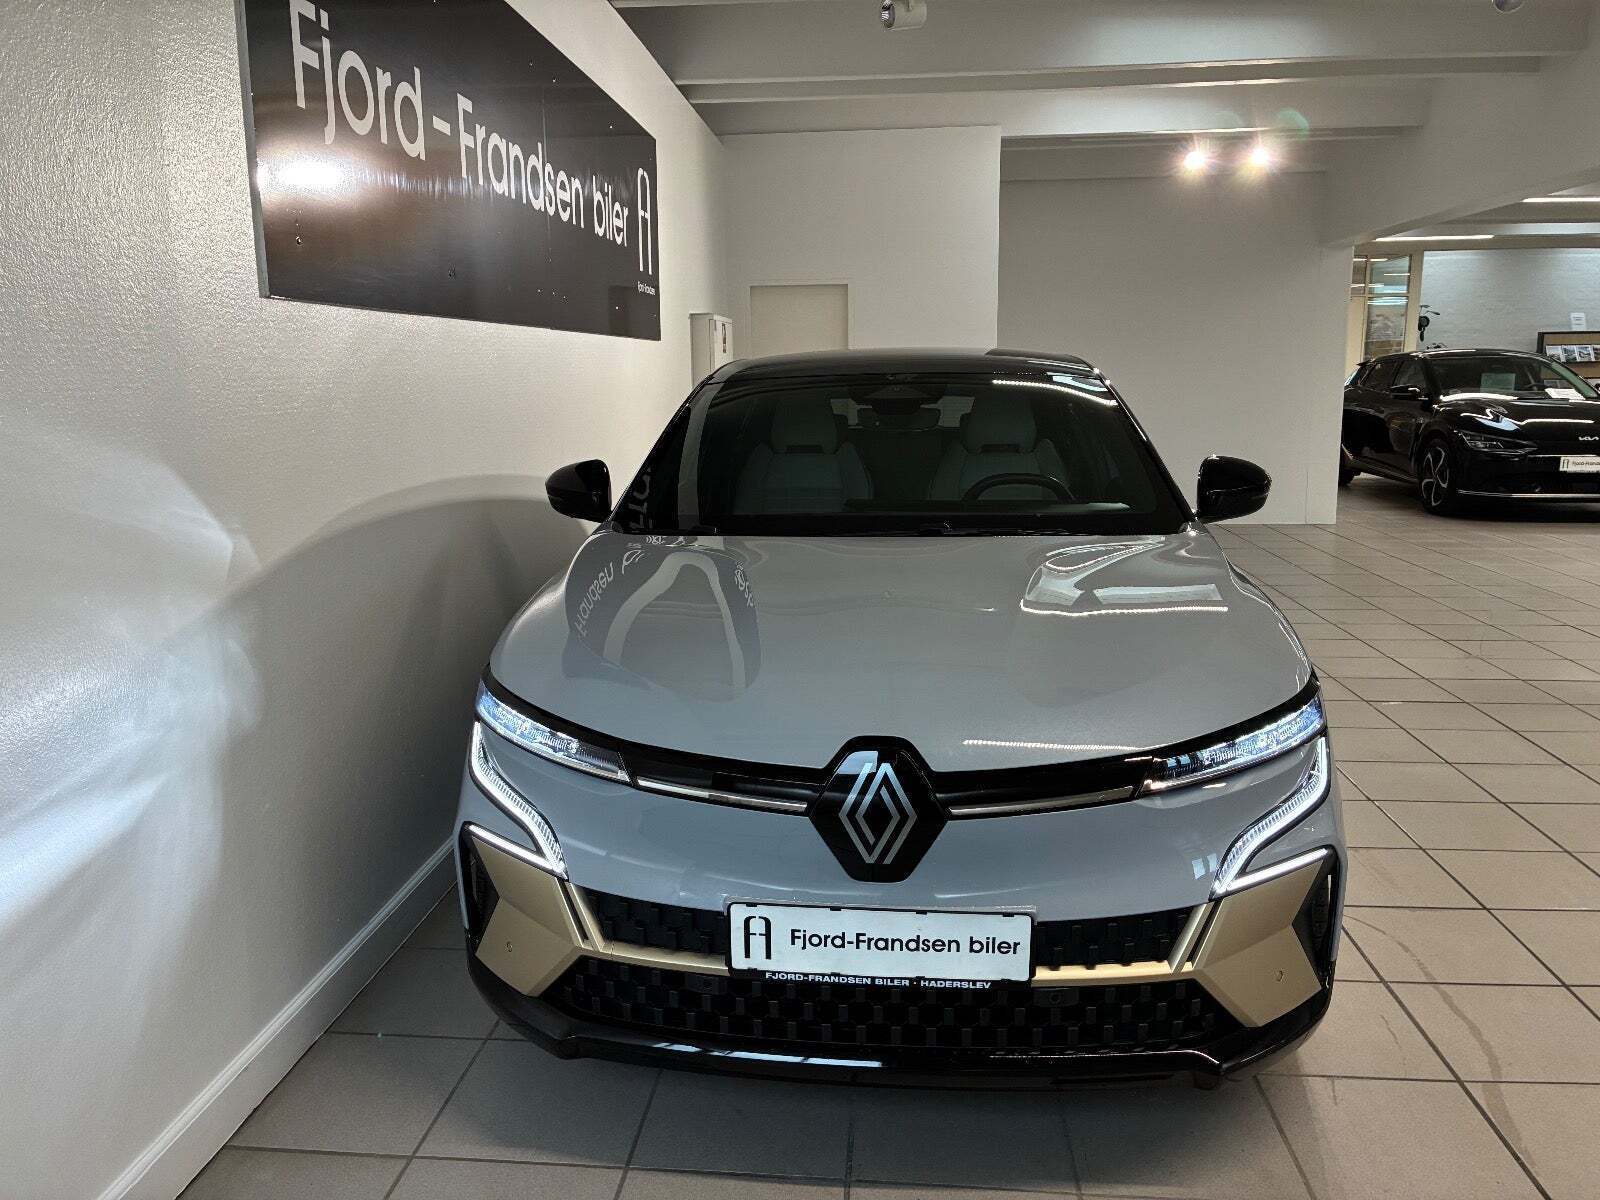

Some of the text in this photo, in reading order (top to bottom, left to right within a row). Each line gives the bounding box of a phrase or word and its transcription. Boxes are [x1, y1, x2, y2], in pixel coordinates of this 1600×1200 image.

[593, 175, 629, 247] biler
[790, 928, 1021, 954] Fjord-Frandsen biler
[765, 972, 992, 989] FJORD-FRANDSEN BILER HADERSLEV
